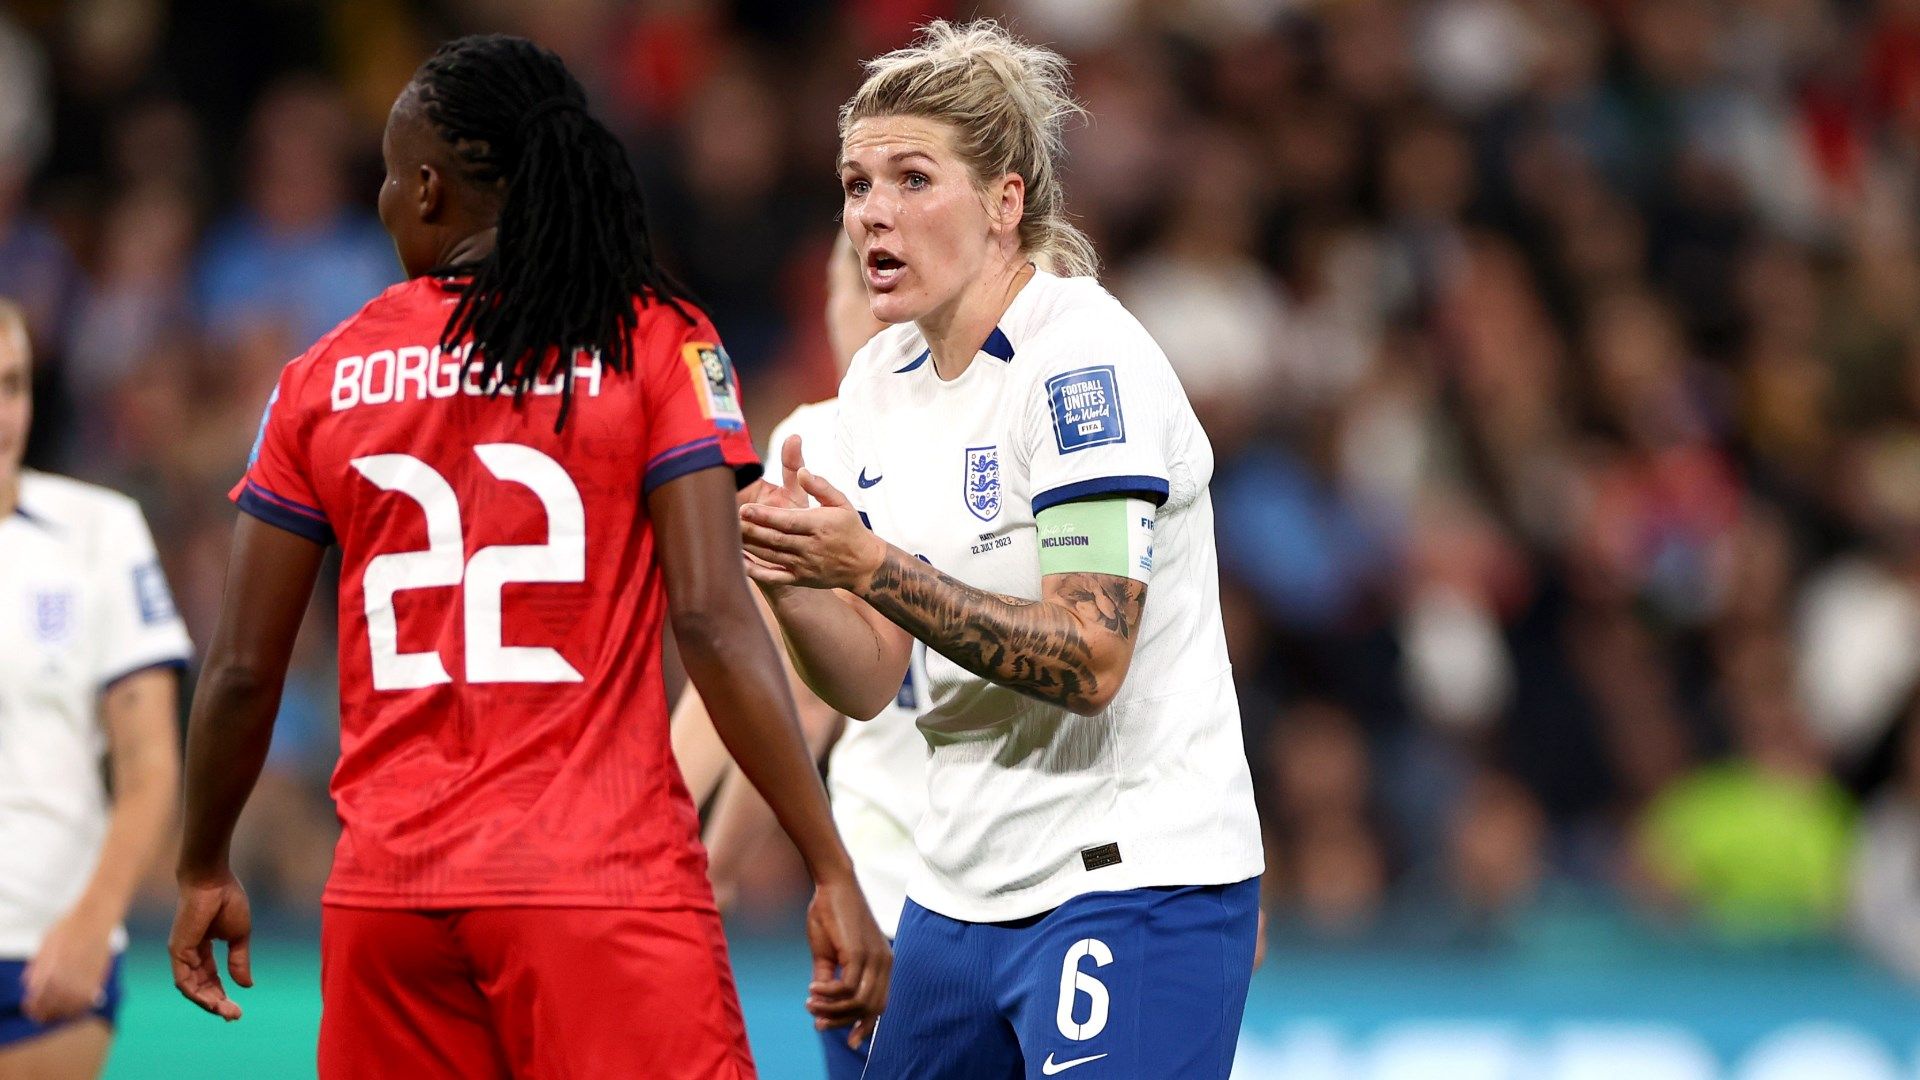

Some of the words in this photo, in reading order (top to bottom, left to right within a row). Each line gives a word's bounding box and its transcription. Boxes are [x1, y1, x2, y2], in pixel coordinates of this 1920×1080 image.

[1061, 380, 1103, 397] FOOTBALL
[1063, 390, 1106, 411] UNITES
[1064, 411, 1080, 425] the
[1081, 404, 1110, 421] World
[1081, 424, 1099, 432] FIFA
[971, 545, 980, 555] 22
[980, 542, 994, 552] JULY
[994, 536, 1012, 549] 2023
[1041, 536, 1090, 548] INCLUSION
[350, 442, 586, 691] 22
[1056, 938, 1114, 1041] 6
